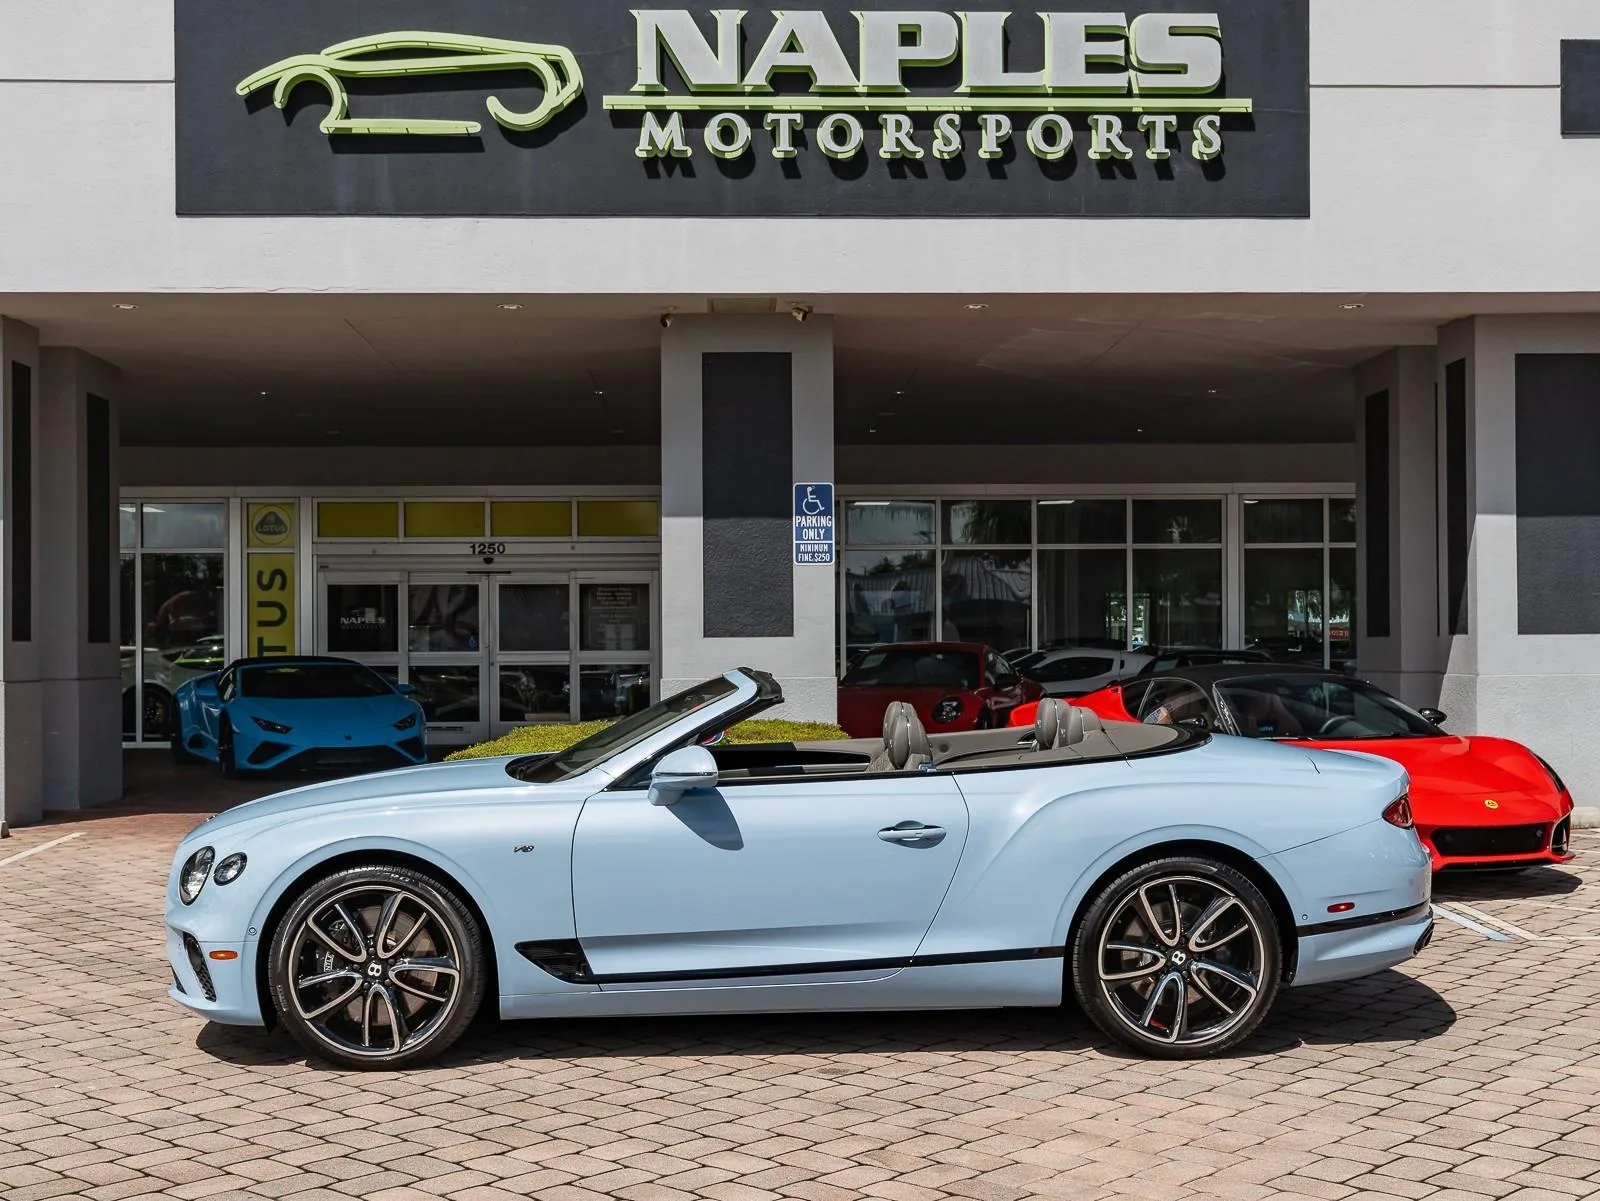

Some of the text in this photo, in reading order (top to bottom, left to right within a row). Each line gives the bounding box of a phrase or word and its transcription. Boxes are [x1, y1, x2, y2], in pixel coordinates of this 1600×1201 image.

[629, 9, 1222, 94] NAPLES
[635, 111, 1222, 160] MOTORSPORTS
[796, 515, 832, 527] PARKING
[802, 528, 825, 540] ONLY
[469, 543, 506, 555] 1250
[800, 543, 828, 552] MINIMUM
[798, 553, 830, 562] FINE $250
[340, 616, 386, 624] NAPLS
